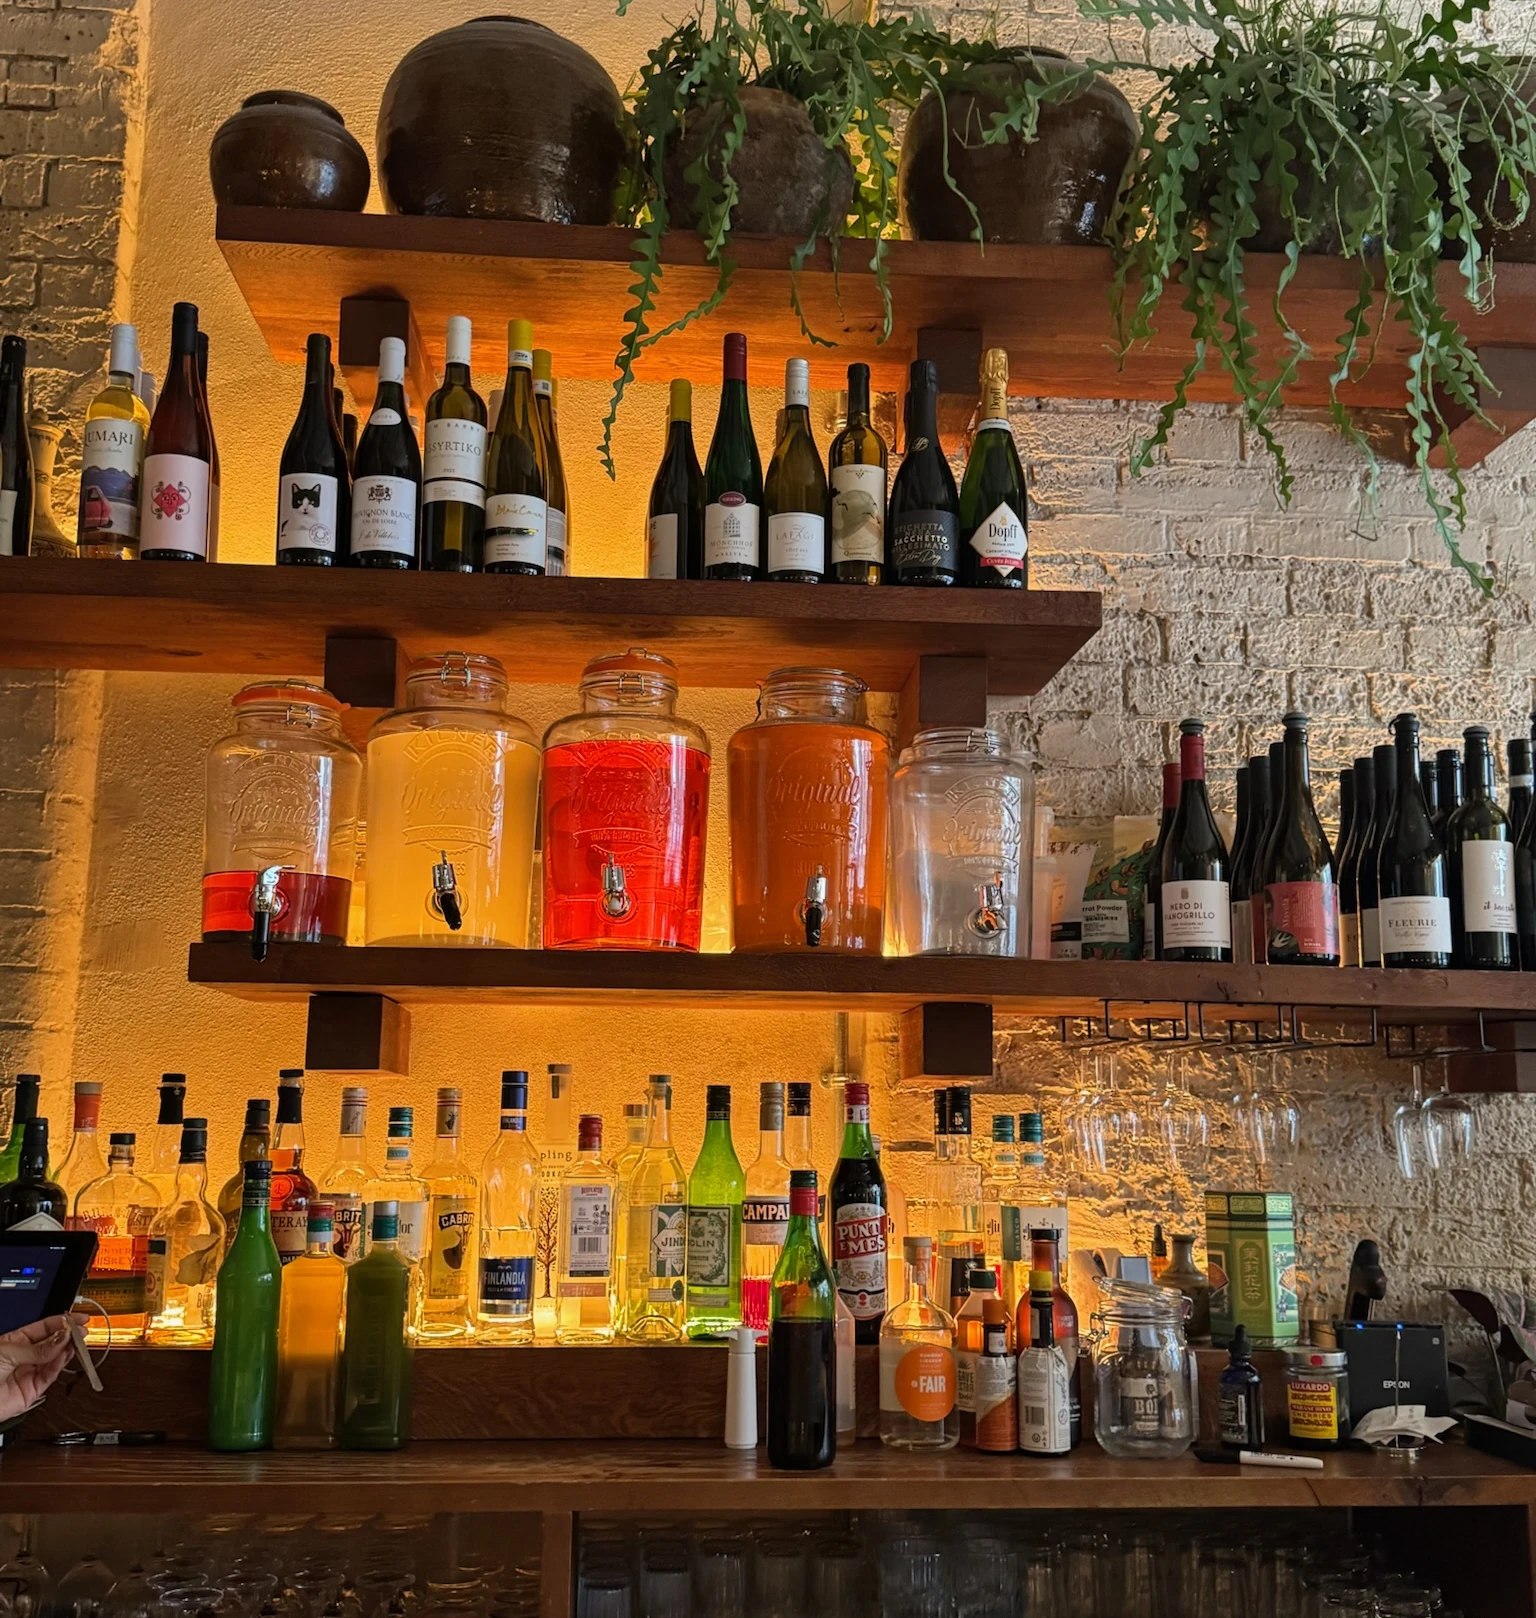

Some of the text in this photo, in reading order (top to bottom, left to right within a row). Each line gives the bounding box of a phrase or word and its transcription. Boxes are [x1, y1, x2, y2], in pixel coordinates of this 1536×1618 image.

[988, 522, 1018, 542] Dopff
[893, 534, 948, 547] SACCHETTO
[401, 781, 504, 822] Original
[229, 799, 320, 832] Original
[1169, 902, 1203, 911] NERO DI
[1388, 919, 1437, 928] FLEURIE
[335, 1211, 361, 1222] BRIT
[838, 1223, 881, 1241] PUNT
[848, 1235, 886, 1254] MES
[483, 1271, 526, 1285] FINLANDIA
[919, 1375, 946, 1393] FAIR
[1291, 1382, 1329, 1391] LUXARDO
